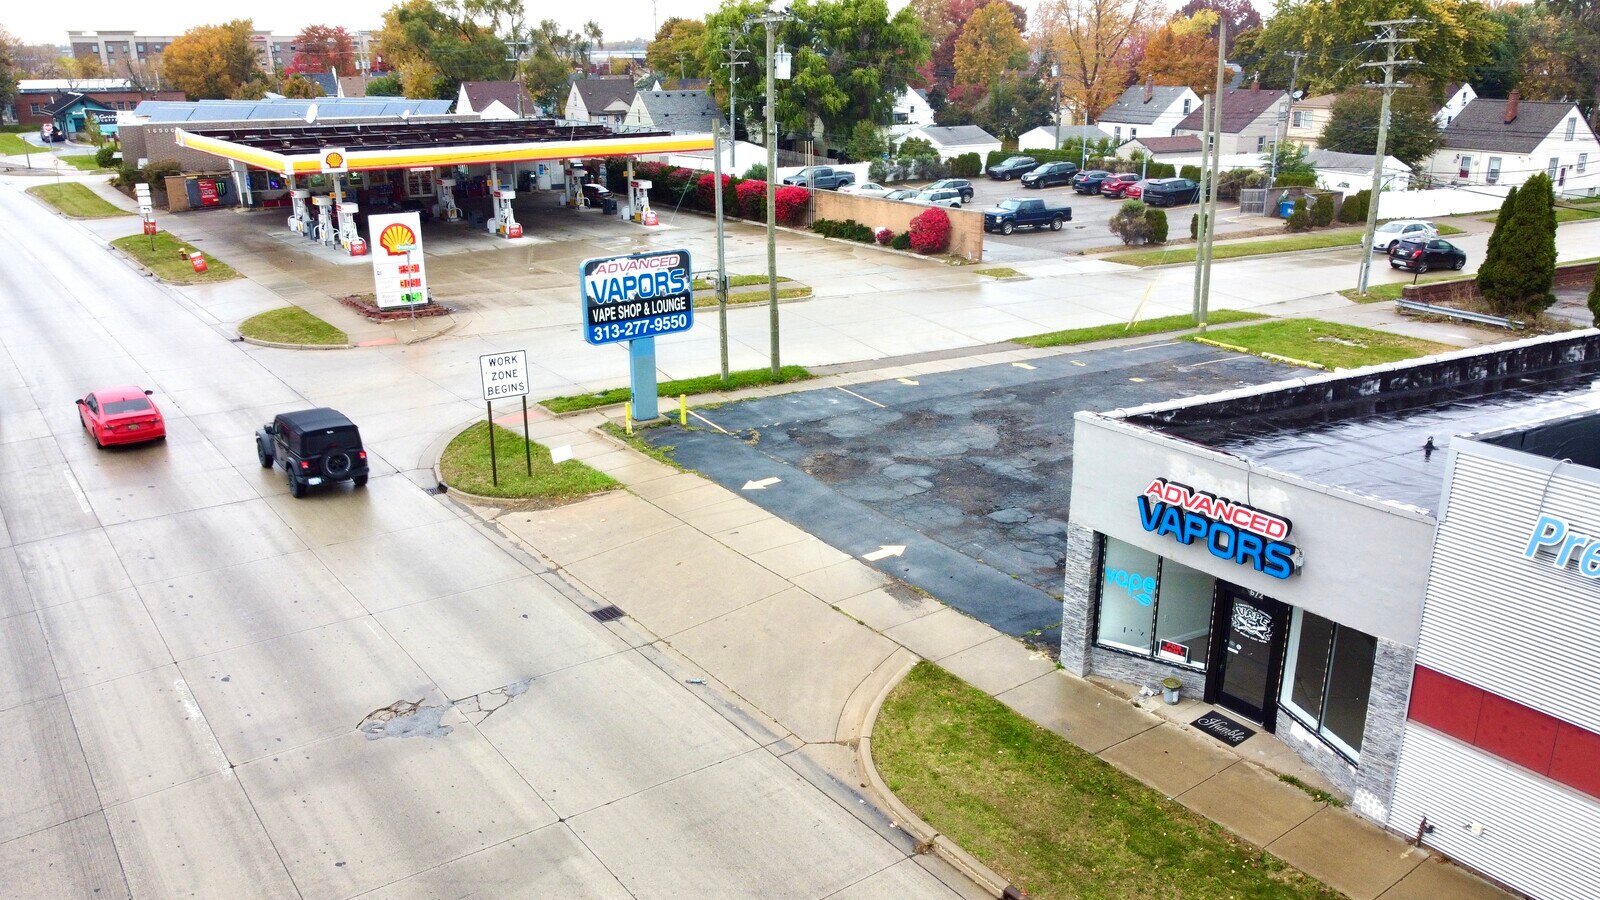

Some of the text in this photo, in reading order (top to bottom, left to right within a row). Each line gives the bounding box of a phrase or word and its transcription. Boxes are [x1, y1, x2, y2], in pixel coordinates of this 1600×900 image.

[596, 255, 680, 275] ADVANCED
[591, 269, 685, 304] VAPORS
[593, 297, 686, 323] VAPE SHOP & LOUNGE
[593, 314, 687, 340] 313-277-9550
[489, 355, 518, 367] WORK
[491, 369, 518, 381] ZONE
[488, 382, 525, 396] BEGINS
[1145, 480, 1288, 540] ADVANCED
[1137, 495, 1294, 579] VAPORS
[1105, 566, 1156, 596] vape
[1235, 606, 1271, 627] VAPE
[1198, 718, 1245, 741] Humble
